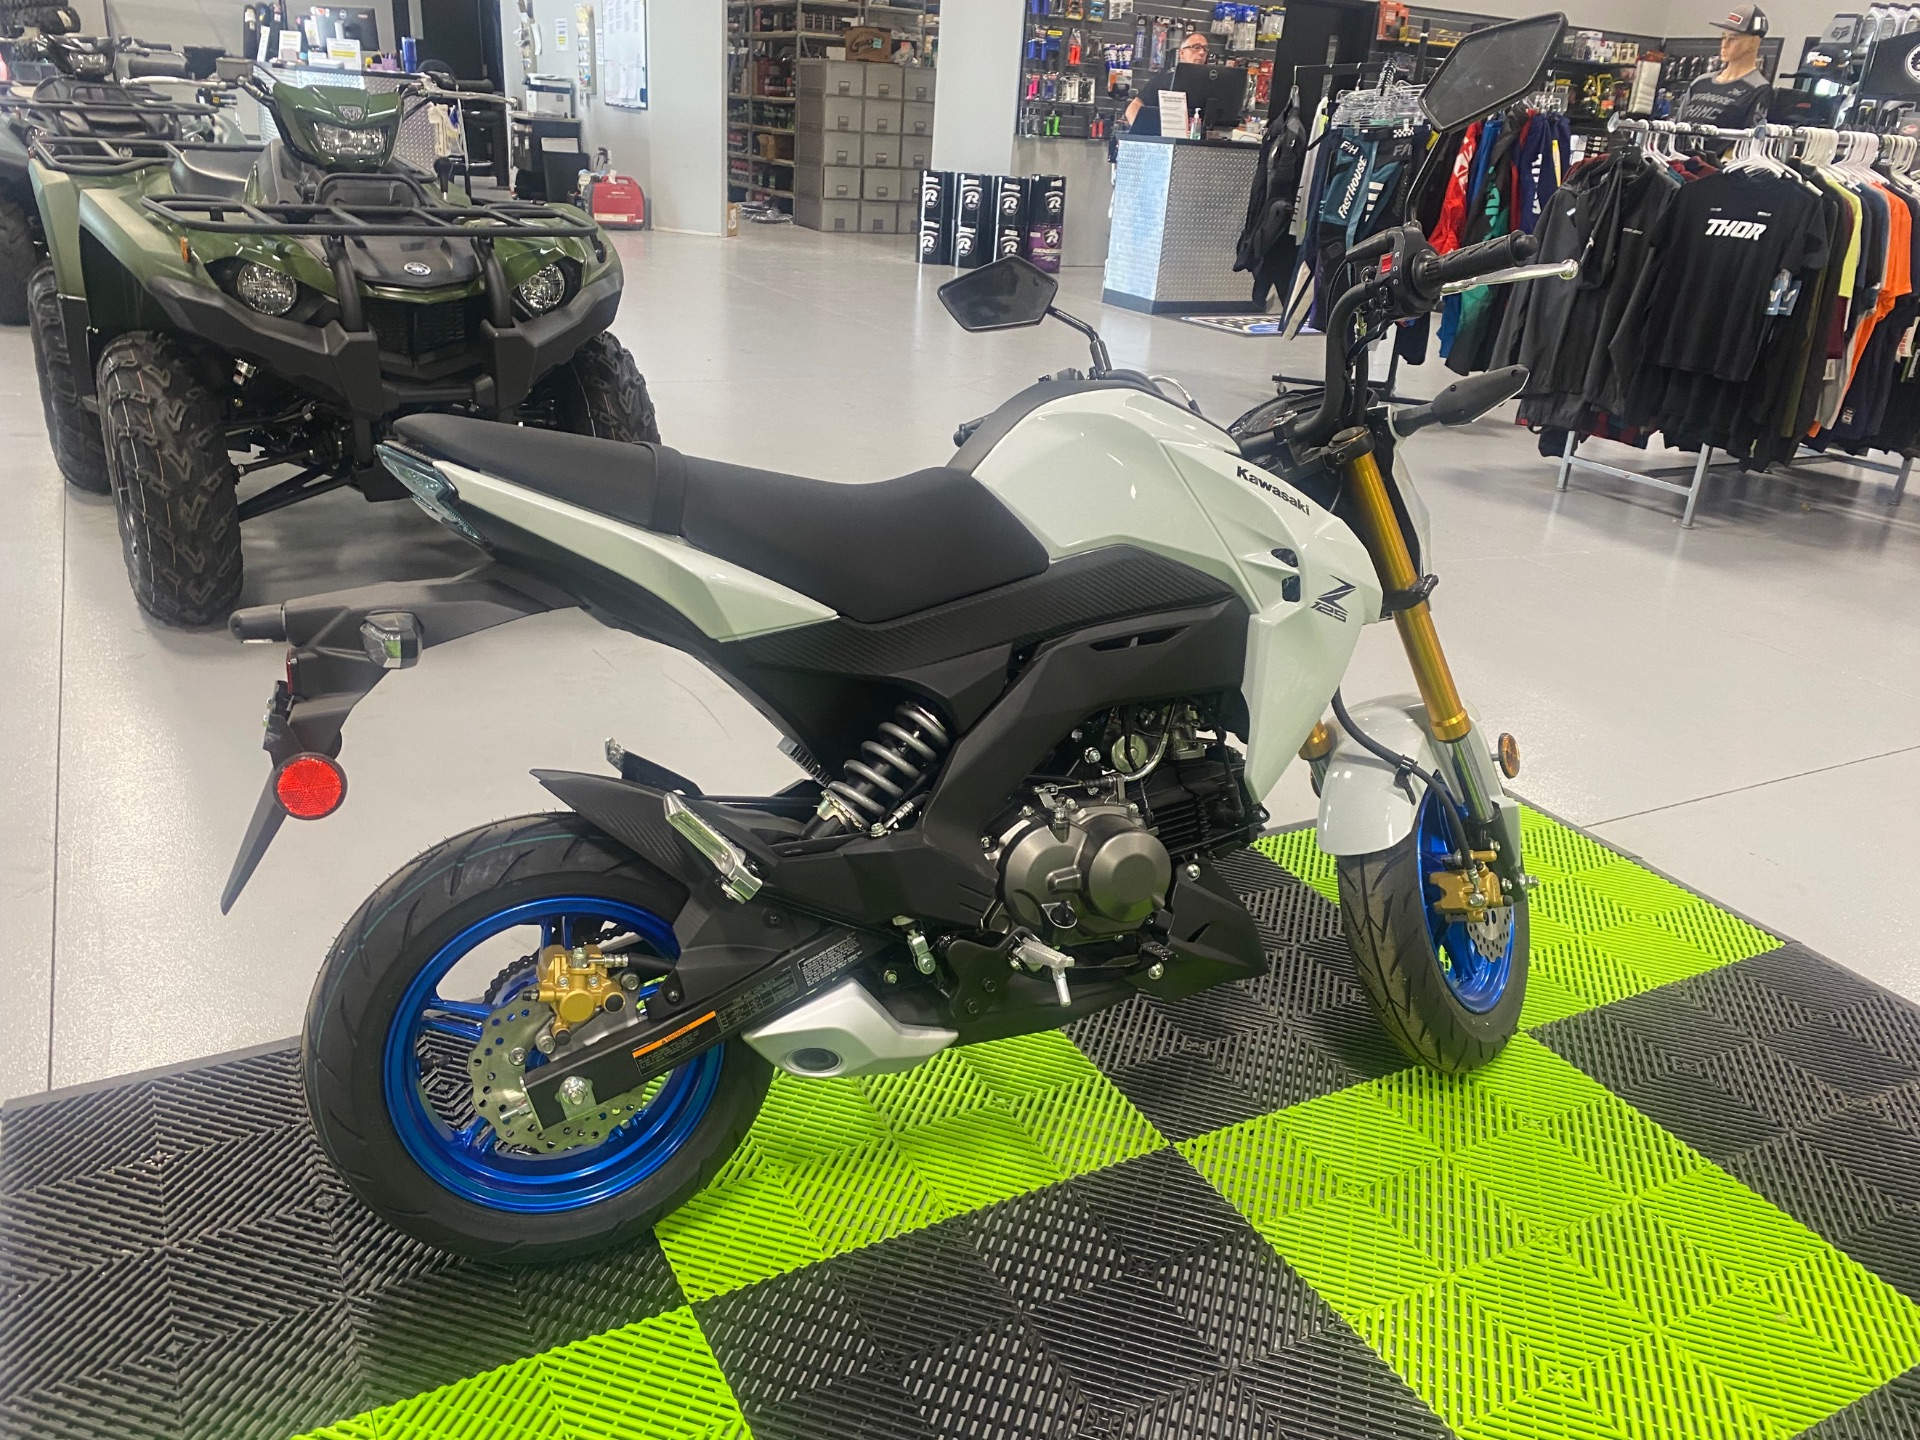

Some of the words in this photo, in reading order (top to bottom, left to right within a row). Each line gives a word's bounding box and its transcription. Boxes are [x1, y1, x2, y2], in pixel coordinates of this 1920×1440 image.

[1338, 155, 1367, 219] FASTHOUSE
[1705, 219, 1767, 241] THOR
[1236, 466, 1310, 516] Kawasaki
[1310, 601, 1348, 623] 125
[1318, 574, 1356, 613] Z
